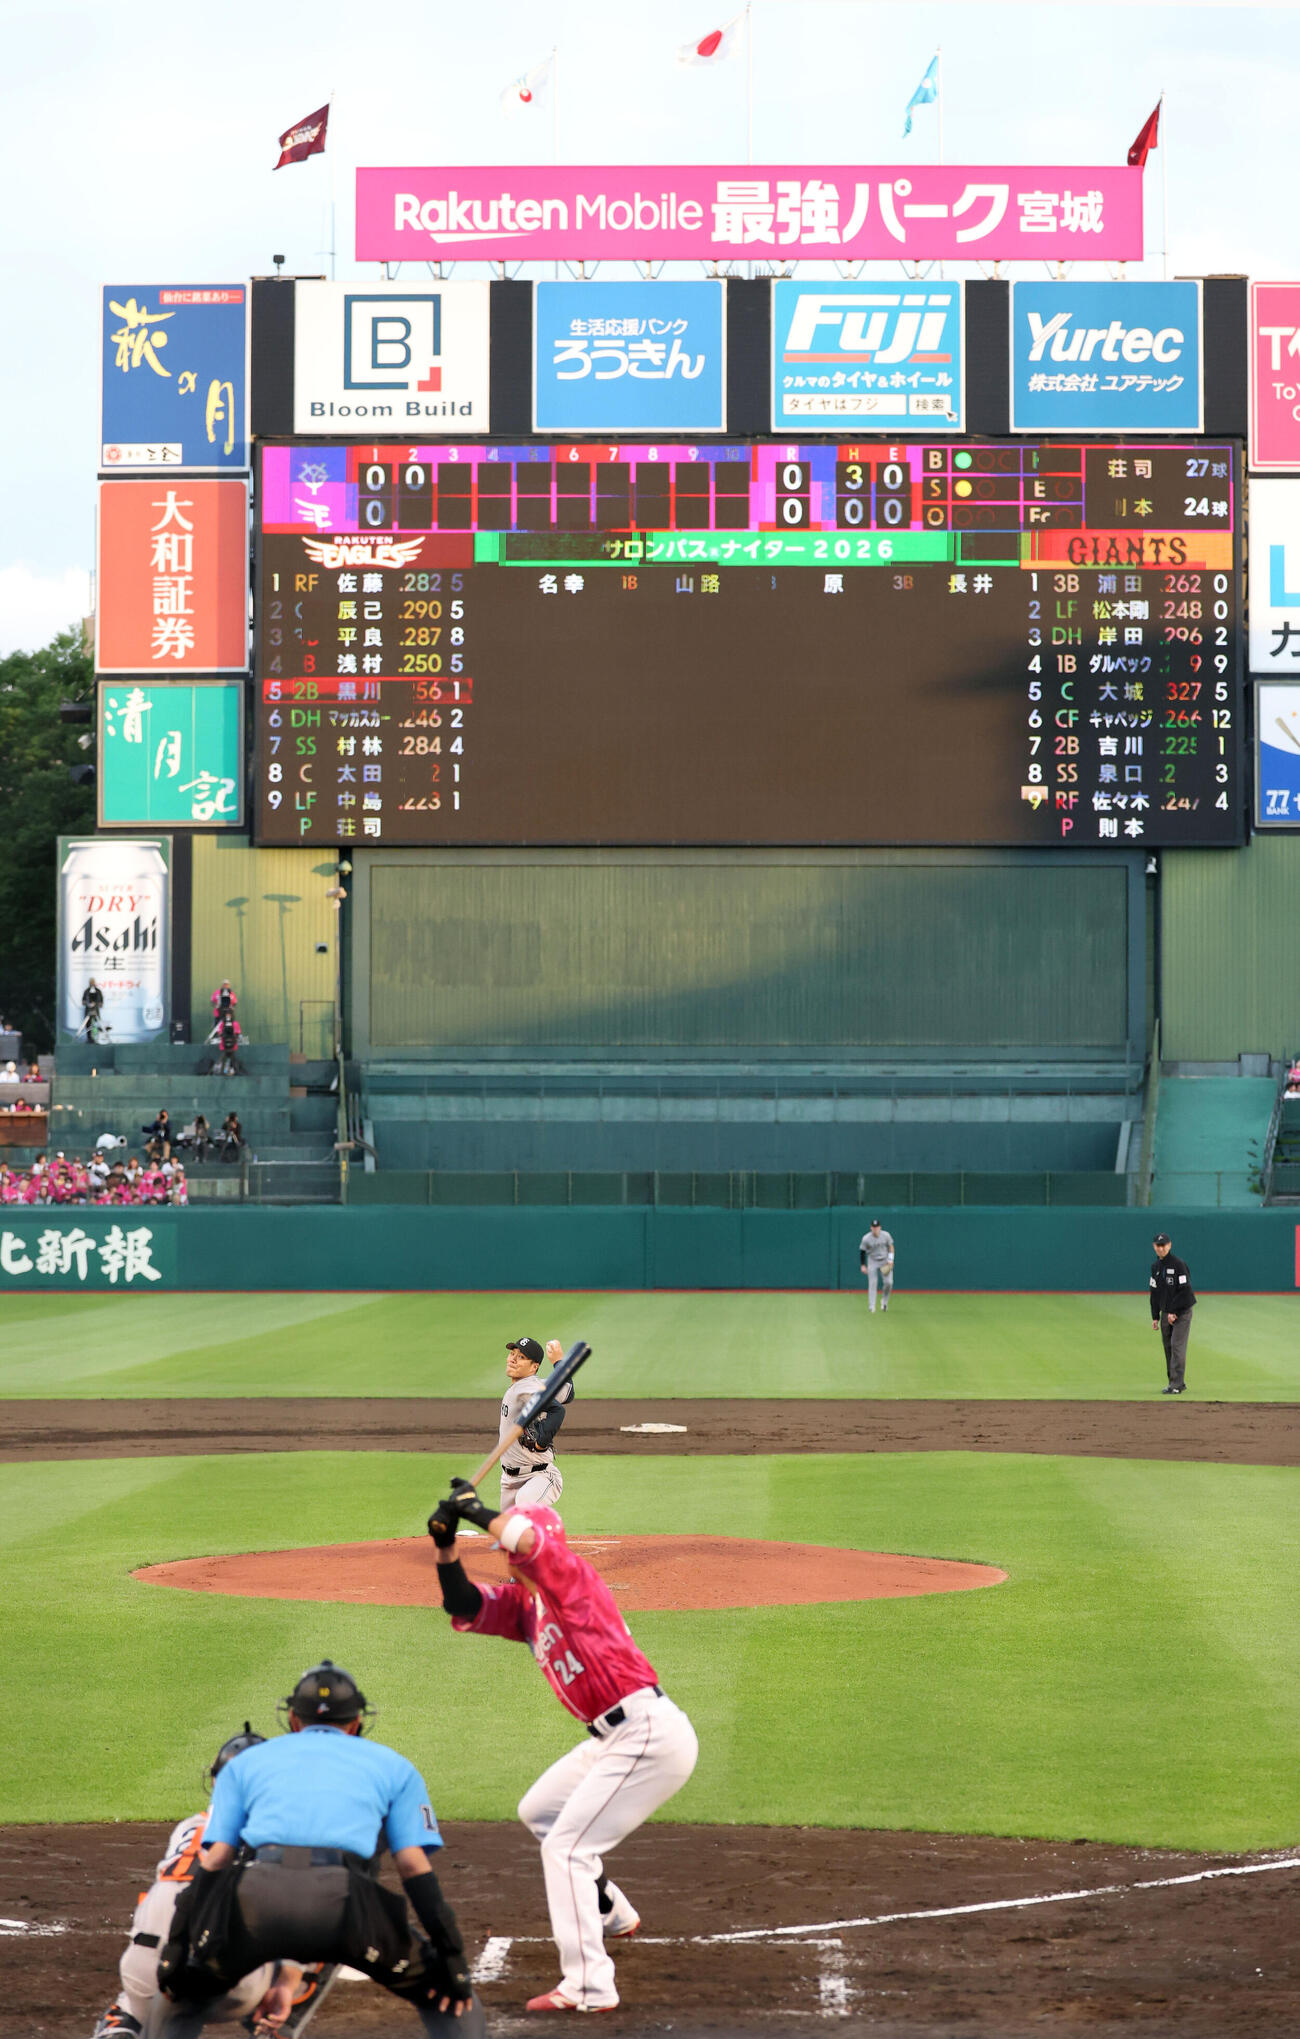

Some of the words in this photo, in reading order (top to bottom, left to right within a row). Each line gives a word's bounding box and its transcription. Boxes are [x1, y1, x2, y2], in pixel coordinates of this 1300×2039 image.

[395, 191, 568, 231] Rakuten
[575, 192, 703, 231] Mobile
[711, 178, 1009, 245] 最強パーク
[1018, 190, 1104, 234] 宮城
[570, 318, 689, 336] 生活応援バンク
[785, 294, 952, 363] Fuji
[1027, 312, 1184, 363] Yurtec
[553, 339, 705, 380] ろうきん
[1028, 373, 1099, 392] 株式会社
[1100, 375, 1184, 392] ユアテック
[310, 401, 393, 417] Bloom
[406, 401, 473, 417] Build
[789, 398, 879, 411] タイヤはフジ
[915, 398, 945, 411] 検索
[372, 448, 378, 461] 1
[408, 448, 418, 461] 2
[449, 448, 458, 461] 3
[569, 447, 579, 461] 6
[609, 447, 618, 461] 7
[648, 447, 658, 461] 8
[688, 447, 699, 461] 9
[786, 447, 796, 461] R
[850, 447, 859, 460] H
[889, 447, 898, 461] E
[929, 451, 943, 469] B
[366, 465, 386, 491] 0
[405, 465, 425, 491] 0
[783, 464, 802, 491] 0
[845, 465, 864, 491] 3
[883, 464, 903, 491] 0
[1108, 459, 1153, 479] 荘司
[930, 479, 941, 497] S
[1034, 480, 1046, 497] E
[366, 500, 386, 526] 0
[783, 498, 802, 524] 0
[844, 498, 863, 525] 0
[884, 498, 903, 525] 0
[926, 507, 944, 525] O
[334, 536, 393, 545] RAKUTEN
[814, 539, 894, 558] 2026
[322, 544, 405, 569] EAGLES
[1068, 537, 1188, 566] GIANTS
[150, 491, 195, 660] 大和証券
[272, 573, 280, 592] 1
[294, 573, 319, 592] RF
[337, 573, 383, 592] 佐藤
[399, 573, 441, 592] .282
[451, 573, 464, 592] 5
[539, 574, 584, 594] 名幸
[675, 574, 720, 594] 山路
[824, 574, 844, 594] 原
[893, 575, 914, 590] 3B
[948, 574, 993, 594] 長井
[1031, 573, 1038, 593] 1
[1054, 573, 1080, 593] 3B
[1098, 573, 1142, 593] 浦田
[1160, 573, 1201, 593] .262
[1213, 573, 1228, 593] 0
[270, 601, 282, 620] 2
[398, 601, 442, 620] .290
[450, 601, 464, 620] 5
[1029, 600, 1041, 620] 2
[1056, 600, 1078, 620] LF
[1092, 600, 1149, 620] 松本剛
[1159, 600, 1202, 620] .248
[1213, 600, 1228, 620] 0
[337, 627, 383, 646] 平良
[399, 627, 442, 646] .287
[450, 627, 464, 646] 8
[1028, 627, 1042, 646] 3
[1052, 627, 1082, 646] DH
[1098, 627, 1143, 646] 岸田
[1215, 627, 1228, 646] 2
[337, 654, 383, 673] 浅村
[398, 654, 442, 673] .250
[450, 654, 463, 673] 5
[1027, 654, 1042, 673] 4
[1056, 654, 1077, 673] 1B
[1089, 654, 1152, 673] ダルベック
[1214, 654, 1228, 673] 9
[269, 681, 282, 700] 5
[294, 681, 319, 700] 2B
[337, 681, 381, 700] 黒川
[453, 681, 460, 700] 1
[1028, 682, 1042, 701] 5
[1061, 682, 1074, 701] C
[1099, 682, 1144, 701] 大城
[1215, 682, 1228, 701] 5
[269, 709, 282, 728] 6
[291, 709, 320, 728] DH
[450, 709, 464, 728] 2
[1028, 709, 1042, 728] 6
[1055, 709, 1079, 728] CF
[1089, 709, 1153, 728] キャベッジ
[1212, 709, 1231, 728] 12
[104, 687, 237, 821] 清月記
[269, 736, 282, 755] 7
[296, 736, 317, 755] SS
[337, 736, 383, 755] 村林
[398, 736, 442, 755] .284
[450, 736, 464, 755] 4
[1028, 736, 1041, 756] 7
[1054, 736, 1080, 756] 2B
[1098, 736, 1143, 756] 吉川
[1217, 736, 1225, 756] 1
[268, 763, 283, 783] 8
[300, 763, 313, 783] C
[337, 763, 382, 783] 太田
[453, 763, 460, 783] 1
[1028, 763, 1042, 783] 8
[1056, 763, 1078, 783] SS
[1099, 763, 1142, 783] 泉口
[1215, 763, 1228, 783] 3
[268, 791, 283, 810] 9
[295, 791, 317, 810] LF
[337, 791, 383, 810] 中島
[453, 791, 460, 810] 1
[1028, 791, 1042, 811] 9
[1055, 791, 1079, 811] RF
[1092, 791, 1150, 811] 佐々木
[1215, 791, 1229, 811] 4
[1266, 789, 1290, 807] 77
[301, 818, 312, 837] P
[337, 818, 382, 837] 荘司
[1061, 818, 1073, 837] P
[1098, 818, 1144, 837] 則本
[72, 915, 157, 952] Asahi
[104, 956, 126, 970] 生
[553, 1649, 585, 1686] 24
